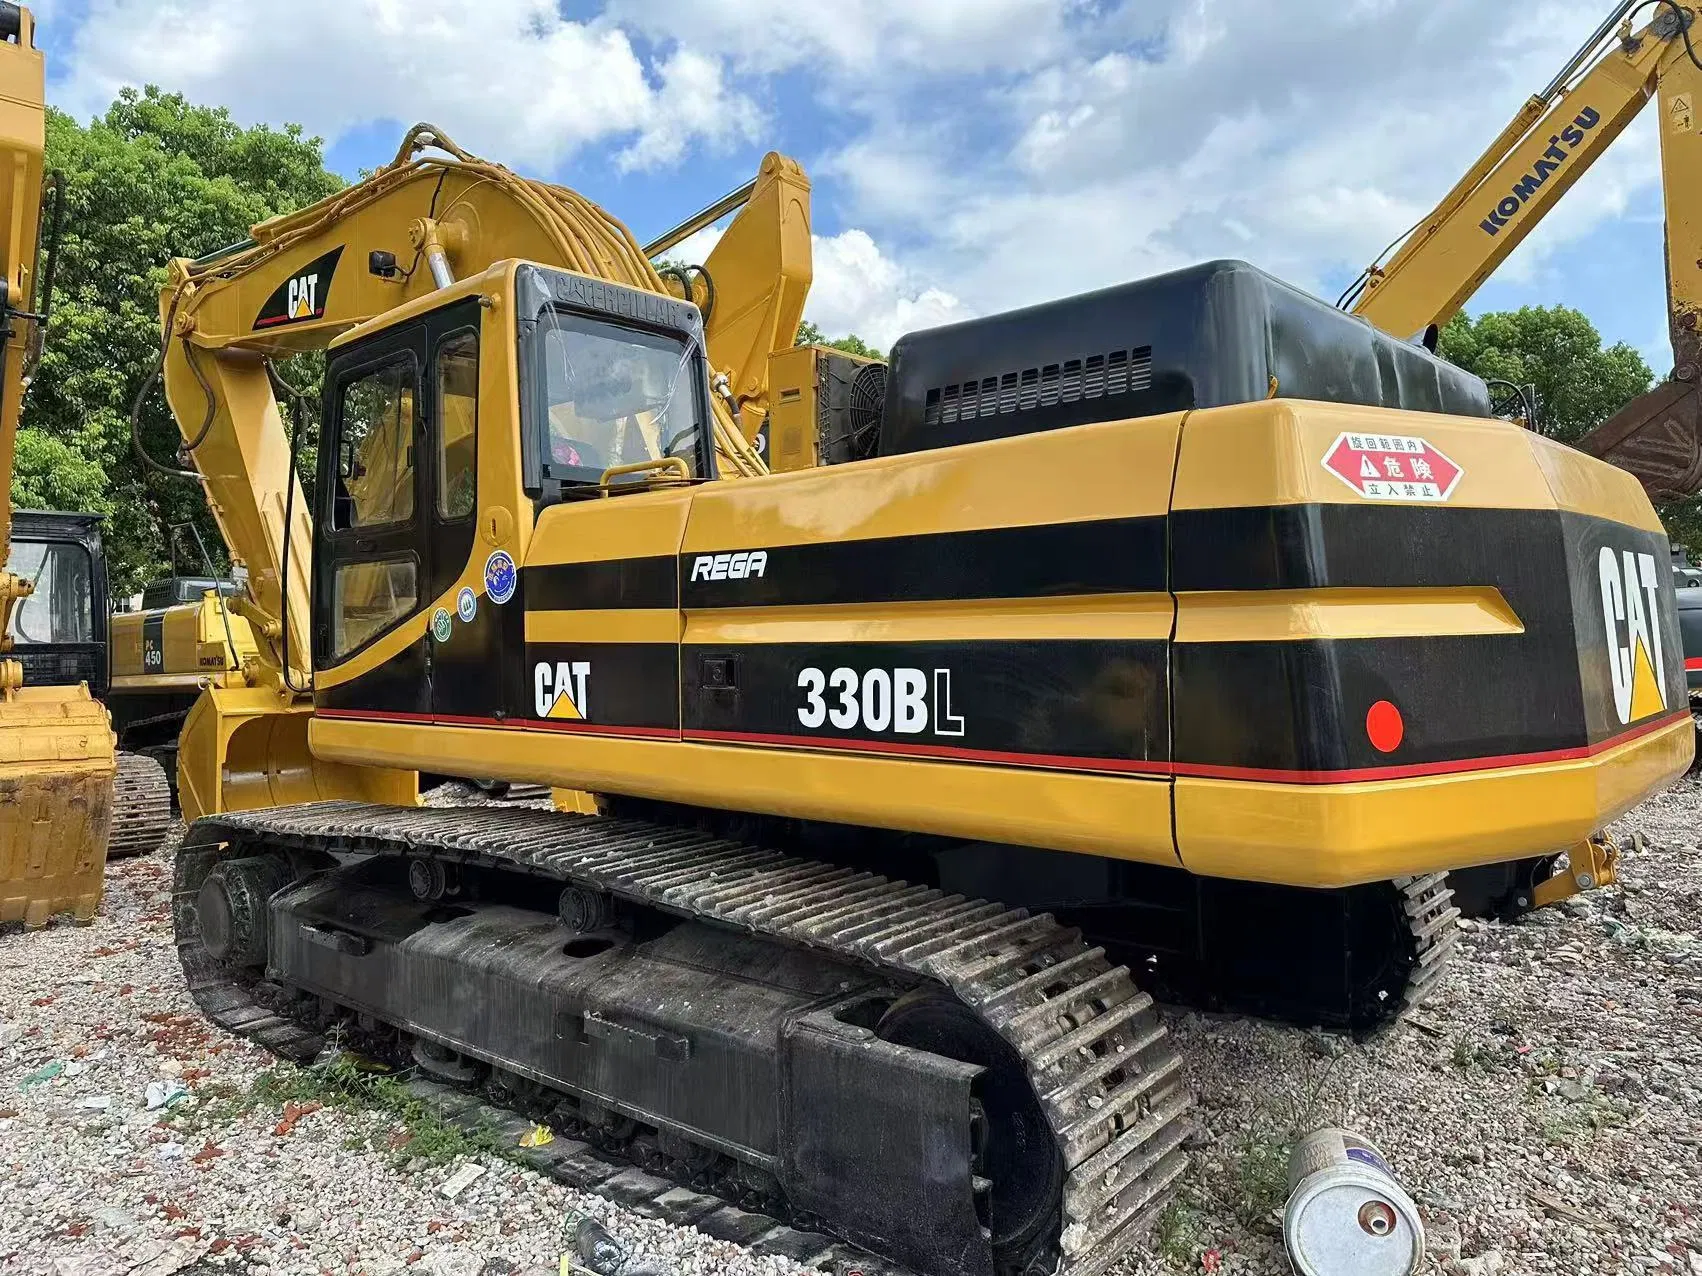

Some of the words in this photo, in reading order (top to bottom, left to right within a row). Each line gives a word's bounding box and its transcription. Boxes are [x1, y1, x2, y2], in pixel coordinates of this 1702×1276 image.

[1478, 105, 1601, 237] KOMATSU
[288, 273, 318, 319] CAT
[555, 275, 680, 328] CATERPILLAR
[1368, 483, 1434, 497] 立入禁止
[1383, 455, 1434, 480] 危険
[690, 551, 768, 582] REGA
[145, 650, 161, 666] 450
[1599, 546, 1668, 725] CAT
[534, 661, 591, 720] CAT
